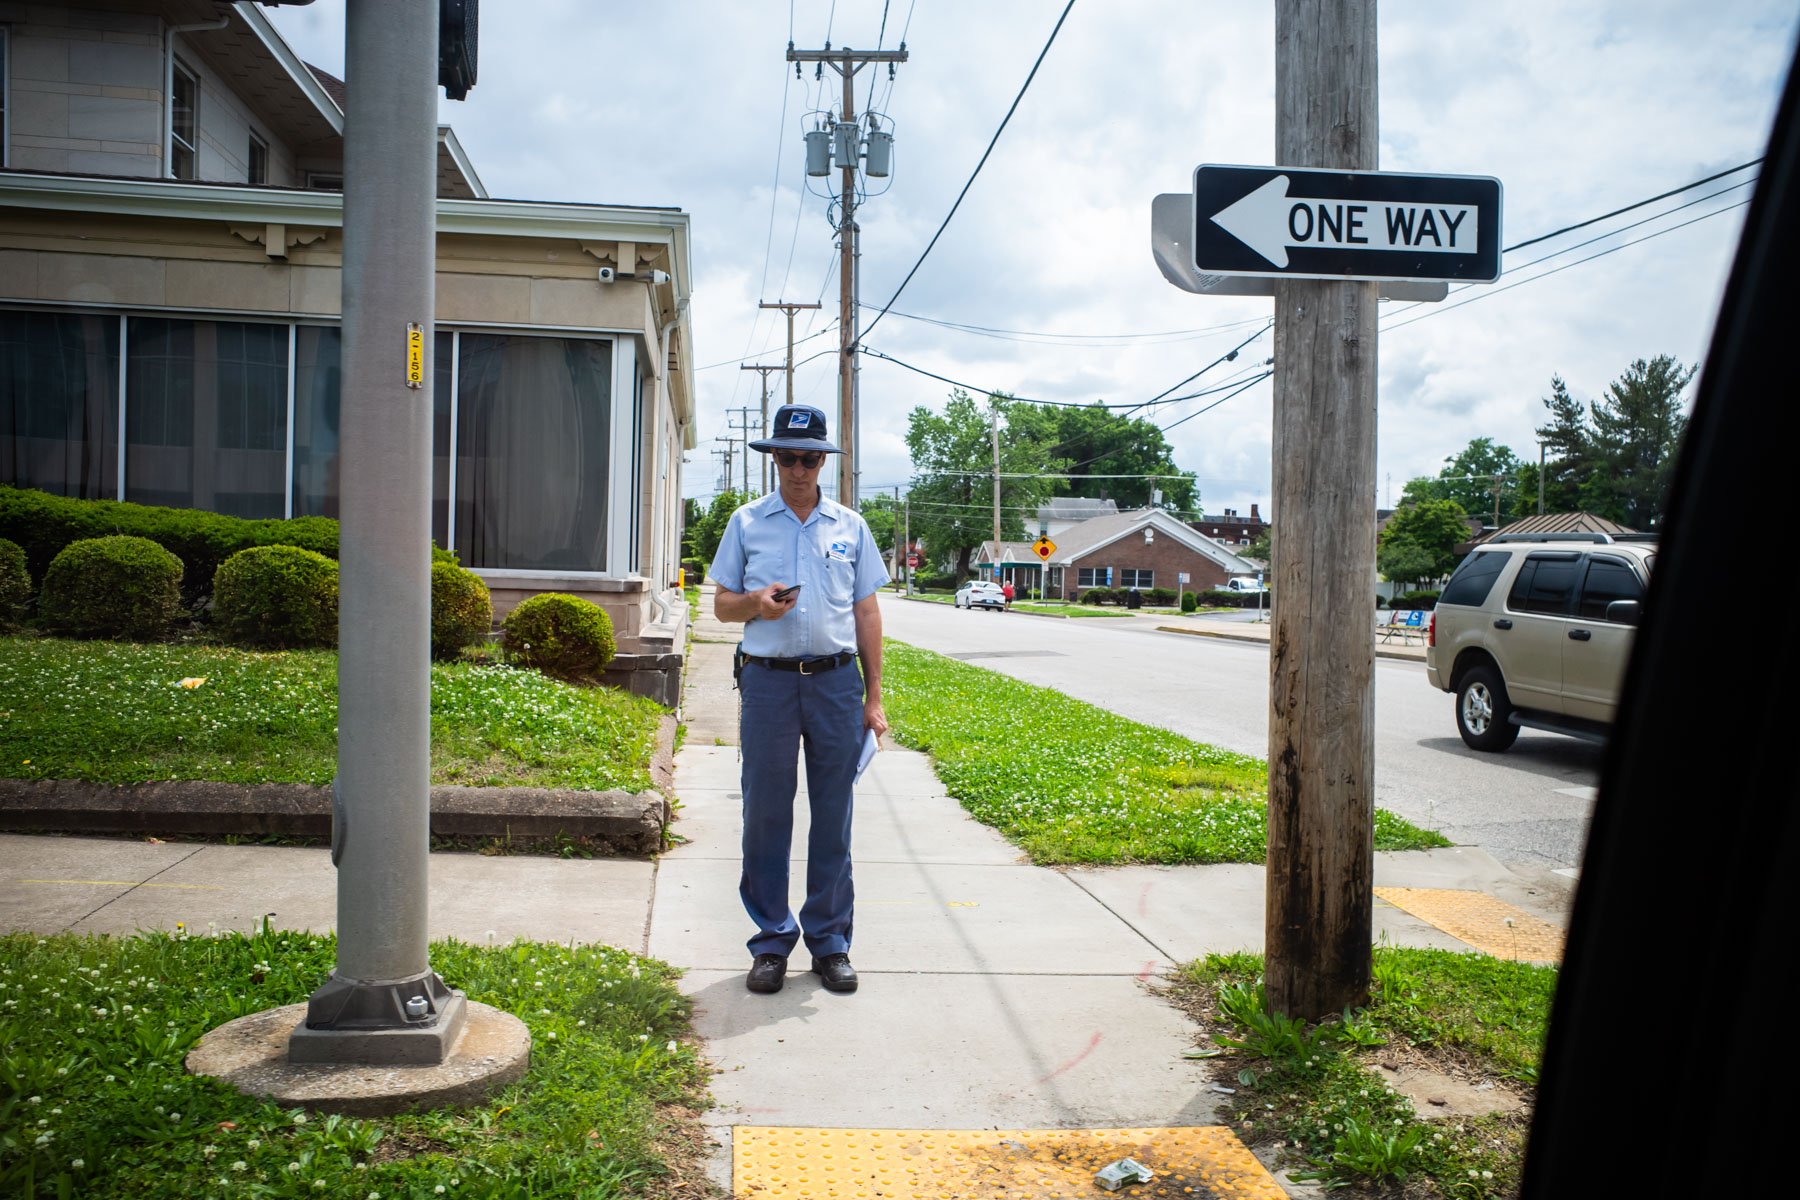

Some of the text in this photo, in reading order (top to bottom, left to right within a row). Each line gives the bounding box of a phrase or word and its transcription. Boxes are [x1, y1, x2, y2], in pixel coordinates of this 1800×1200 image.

[1288, 202, 1468, 248] ONE WAY
[411, 332, 420, 381] 2-156
